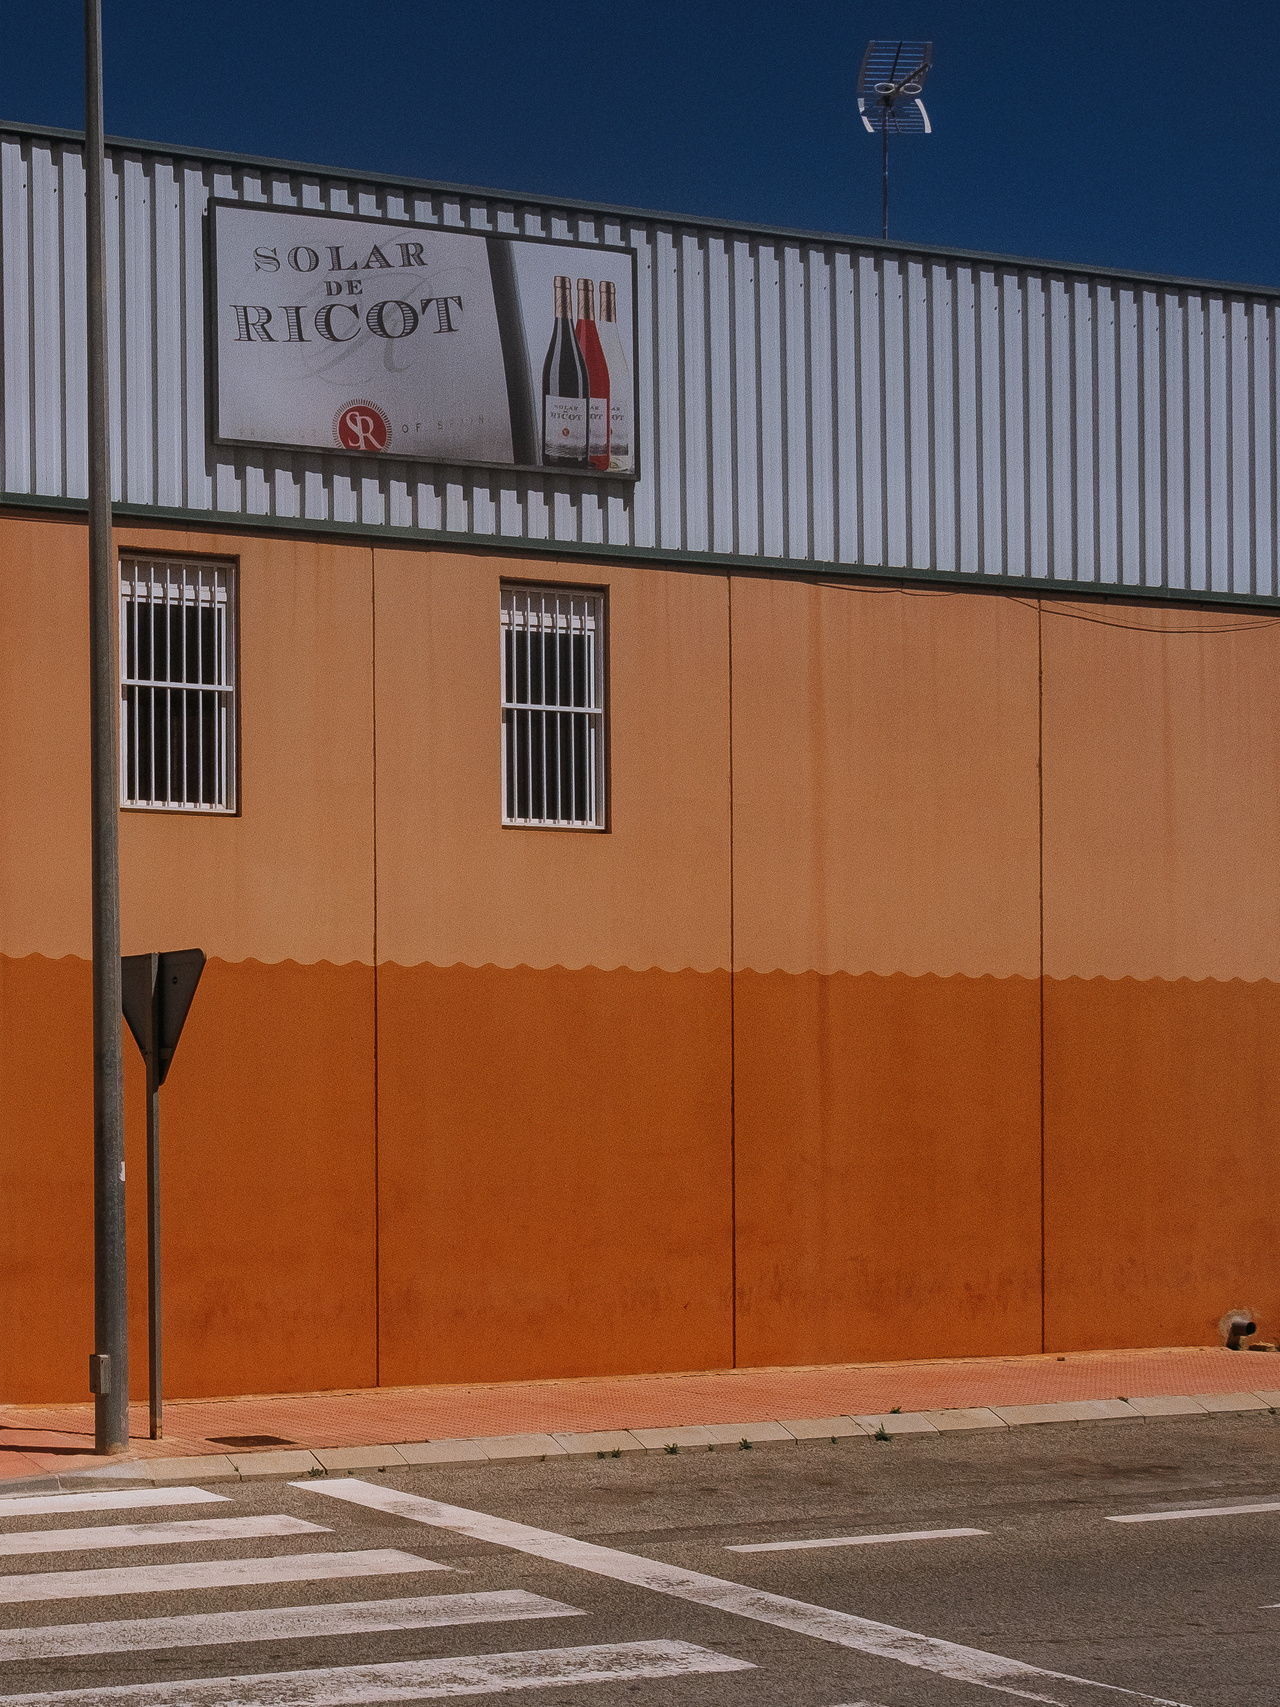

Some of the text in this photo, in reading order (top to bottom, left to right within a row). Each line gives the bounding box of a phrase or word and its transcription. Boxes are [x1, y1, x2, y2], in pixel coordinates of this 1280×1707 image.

[253, 242, 429, 273] SOLAR
[325, 279, 363, 297] DE
[229, 296, 464, 343] RICOT
[401, 414, 485, 434] OF SPN
[550, 412, 583, 421] RICOT
